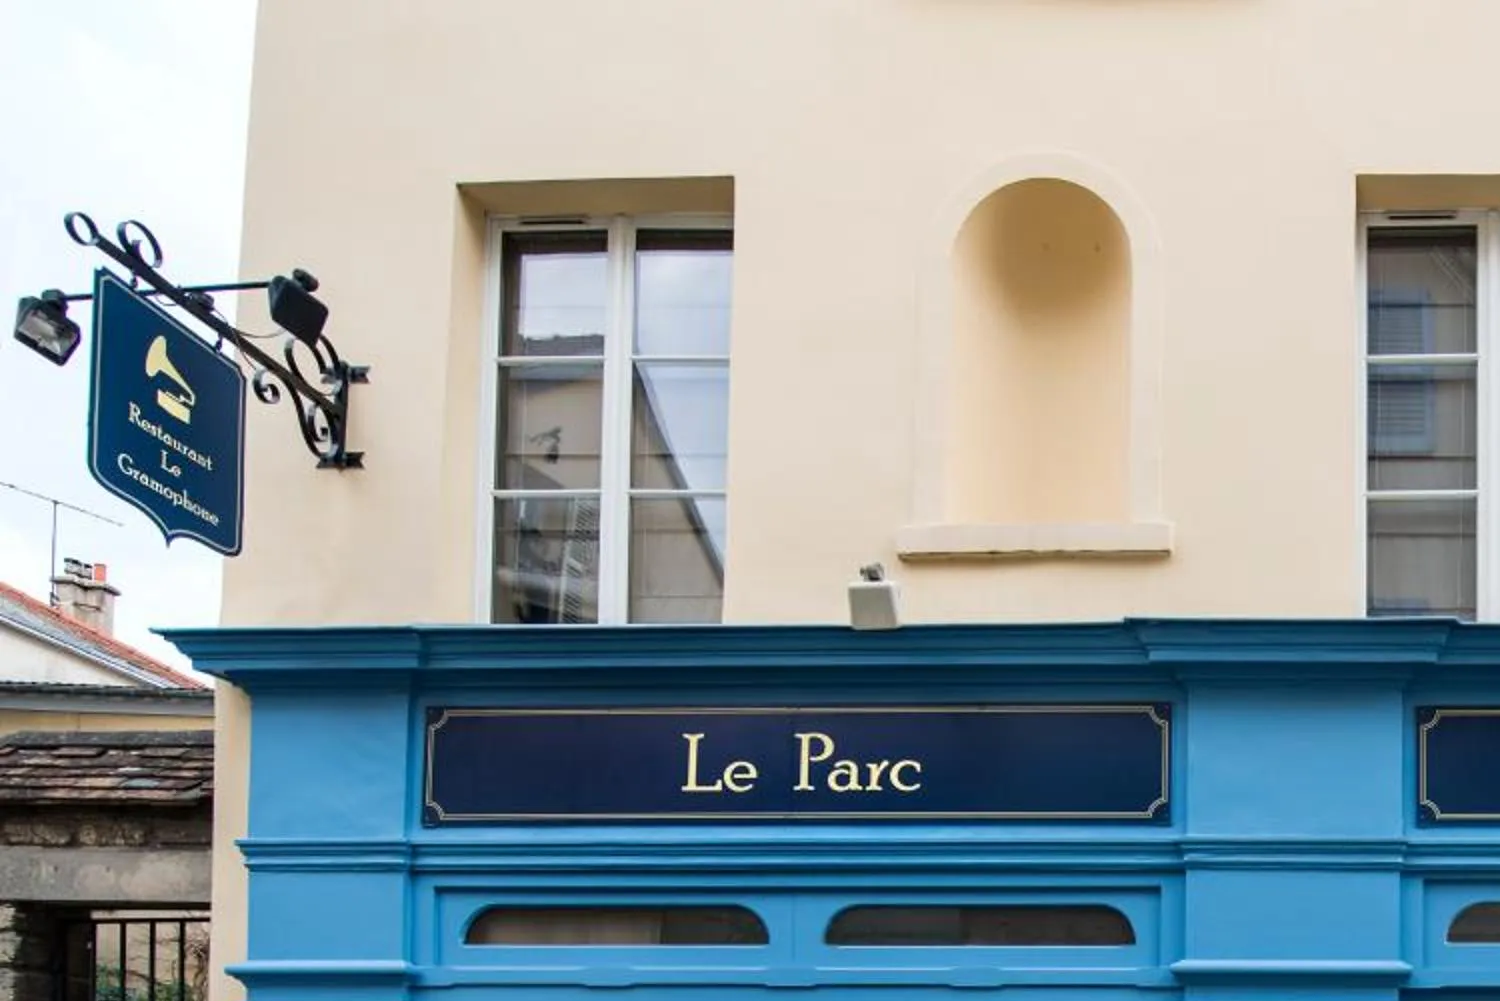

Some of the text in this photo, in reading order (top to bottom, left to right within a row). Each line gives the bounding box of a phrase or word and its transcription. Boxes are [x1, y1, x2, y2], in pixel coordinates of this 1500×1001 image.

[127, 401, 213, 472] Restaurant
[159, 450, 182, 478] Le
[117, 452, 219, 527] Gramophone
[681, 732, 922, 794] Le Parc
